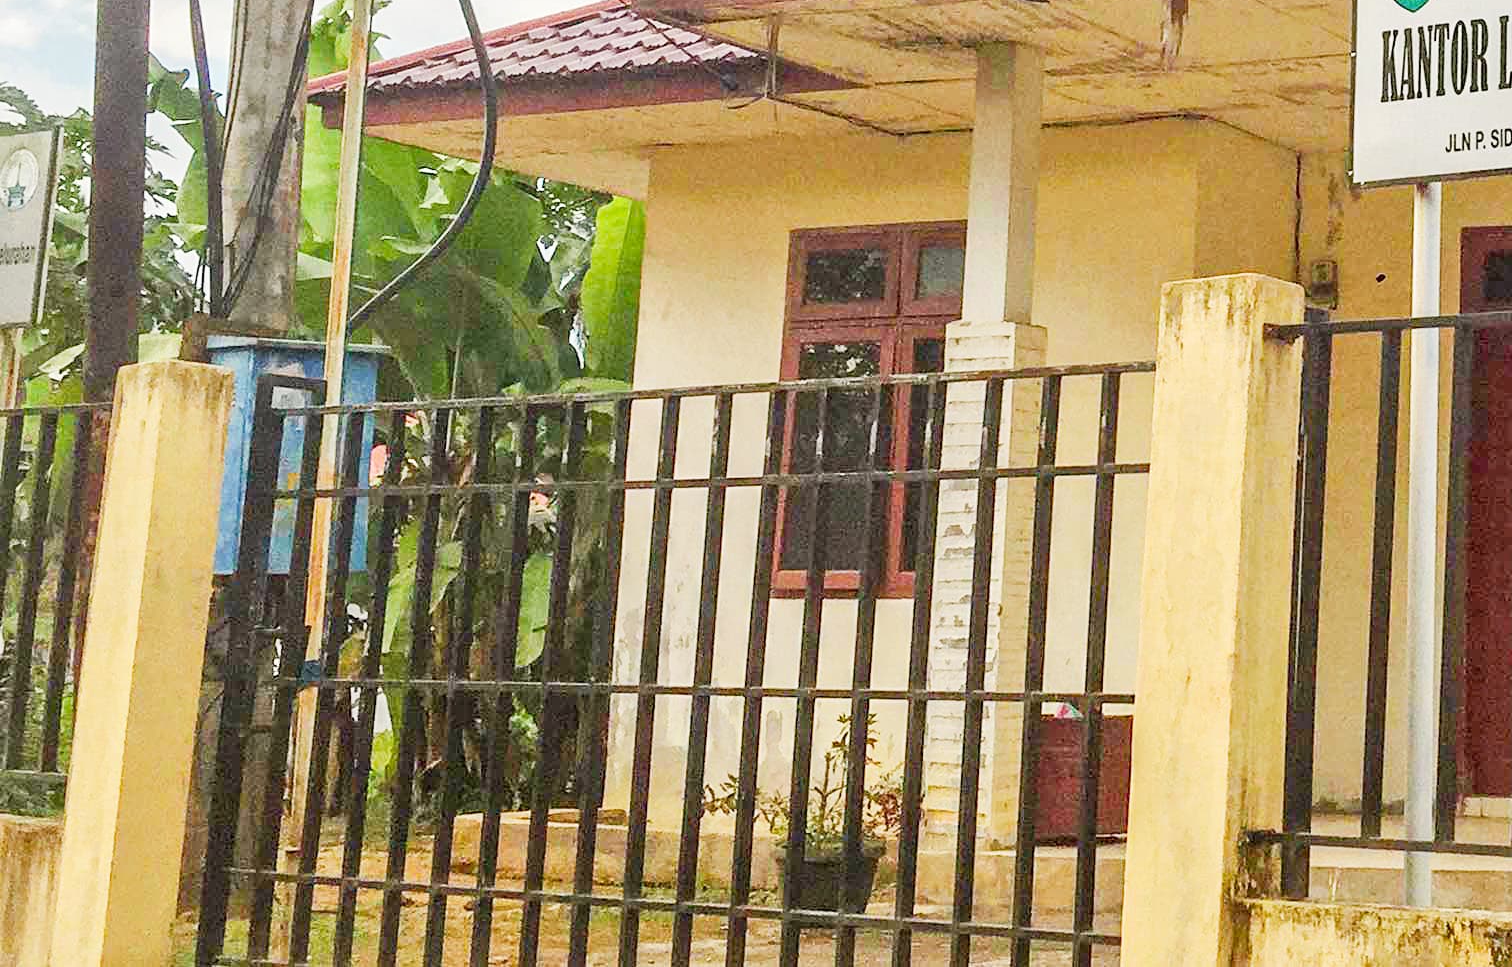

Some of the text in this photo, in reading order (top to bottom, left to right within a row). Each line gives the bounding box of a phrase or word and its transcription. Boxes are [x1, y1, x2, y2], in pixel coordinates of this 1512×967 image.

[1381, 19, 1488, 103] KANTOR
[1445, 132, 1470, 152] JLN
[1476, 131, 1486, 149] P.
